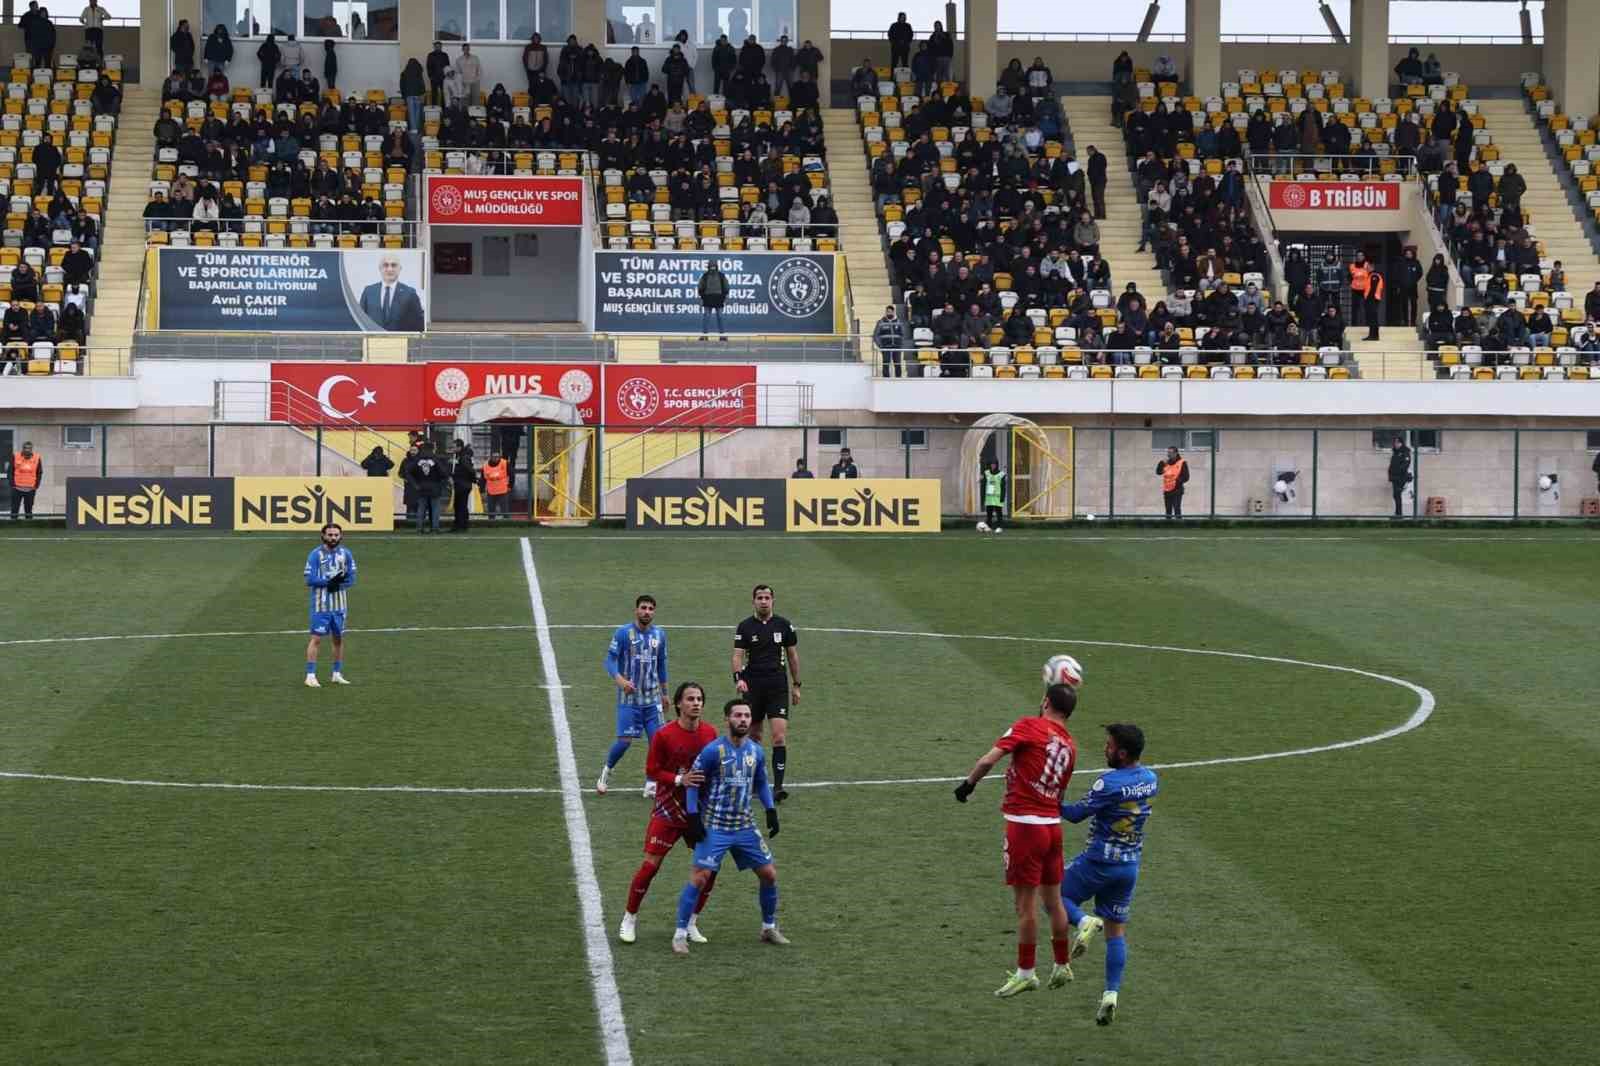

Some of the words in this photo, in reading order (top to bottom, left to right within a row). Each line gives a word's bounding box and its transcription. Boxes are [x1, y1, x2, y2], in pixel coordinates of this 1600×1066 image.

[464, 190, 487, 201] MUŞ
[490, 189, 533, 203] GENÇLİK
[535, 191, 548, 200] VE
[551, 191, 578, 201] SPOR
[1310, 190, 1321, 207] B
[1324, 186, 1387, 207] TRİBÜN
[464, 202, 473, 213] İL
[475, 202, 544, 215] MÜDÜRLÜĞÜ
[195, 253, 227, 266] TÜM
[231, 253, 310, 266] ANTRENÖR
[620, 256, 654, 271] TÜM
[178, 266, 198, 278] VE
[201, 267, 328, 279] SPORCULARIMIZA
[601, 272, 622, 284] VE
[627, 272, 763, 286] SPORCULMIZA
[189, 281, 253, 292] BAŞARILAR
[256, 280, 318, 291] DİLİYORUM
[608, 287, 682, 299] BAŞARILAR
[685, 287, 755, 299] DİRUZ
[211, 295, 240, 306] Avni
[245, 295, 288, 307] ÇAKIR
[221, 308, 243, 317] MUŞ
[246, 307, 278, 317] VALİSİ
[603, 303, 623, 315] MUŞ
[625, 302, 661, 316] GENÇLİK
[663, 304, 675, 314] VE
[677, 304, 700, 315] SPOR
[664, 388, 682, 398] T.C.
[664, 400, 690, 409] SPOR
